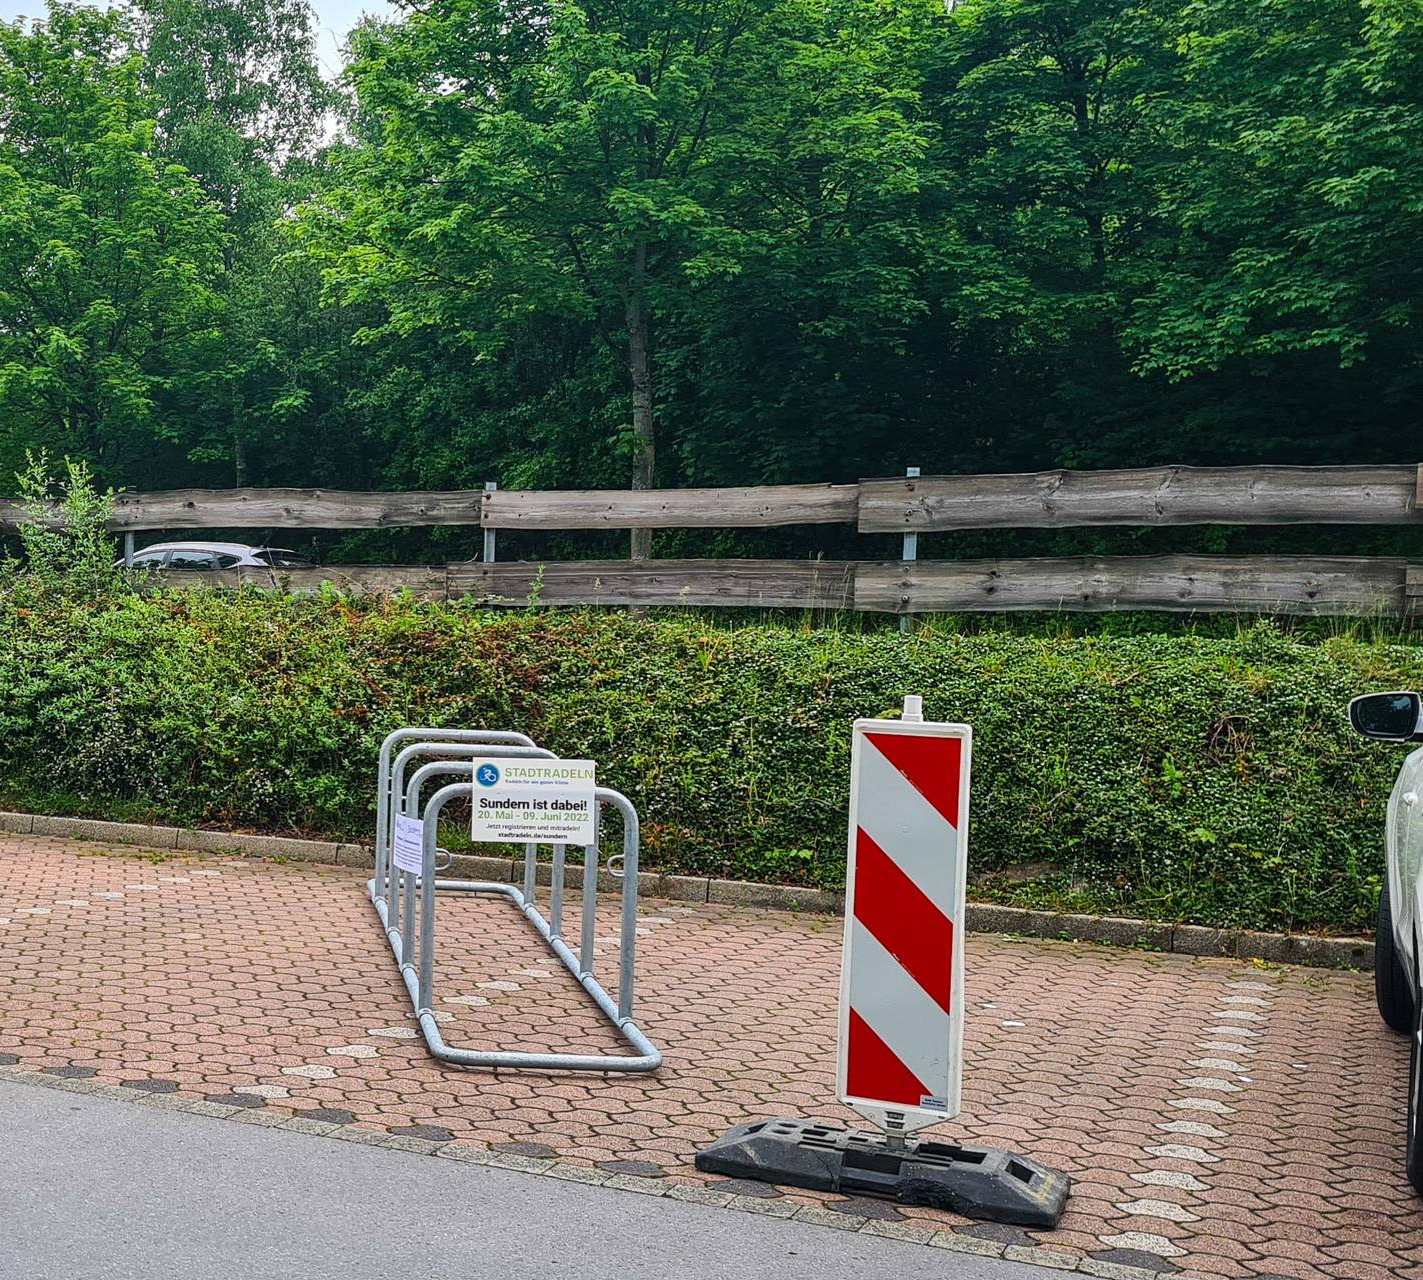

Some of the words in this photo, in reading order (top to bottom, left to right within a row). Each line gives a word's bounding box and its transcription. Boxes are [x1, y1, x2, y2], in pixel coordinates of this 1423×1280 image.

[505, 767, 594, 779] STADTRADELN
[480, 798, 530, 810] Sundern
[533, 798, 548, 810] ist
[550, 799, 588, 811] dabei!
[478, 810, 493, 819] 20.
[495, 810, 513, 820] Mai
[523, 811, 538, 820] 09.
[540, 812, 562, 821] Juni
[564, 812, 589, 822] 2022
